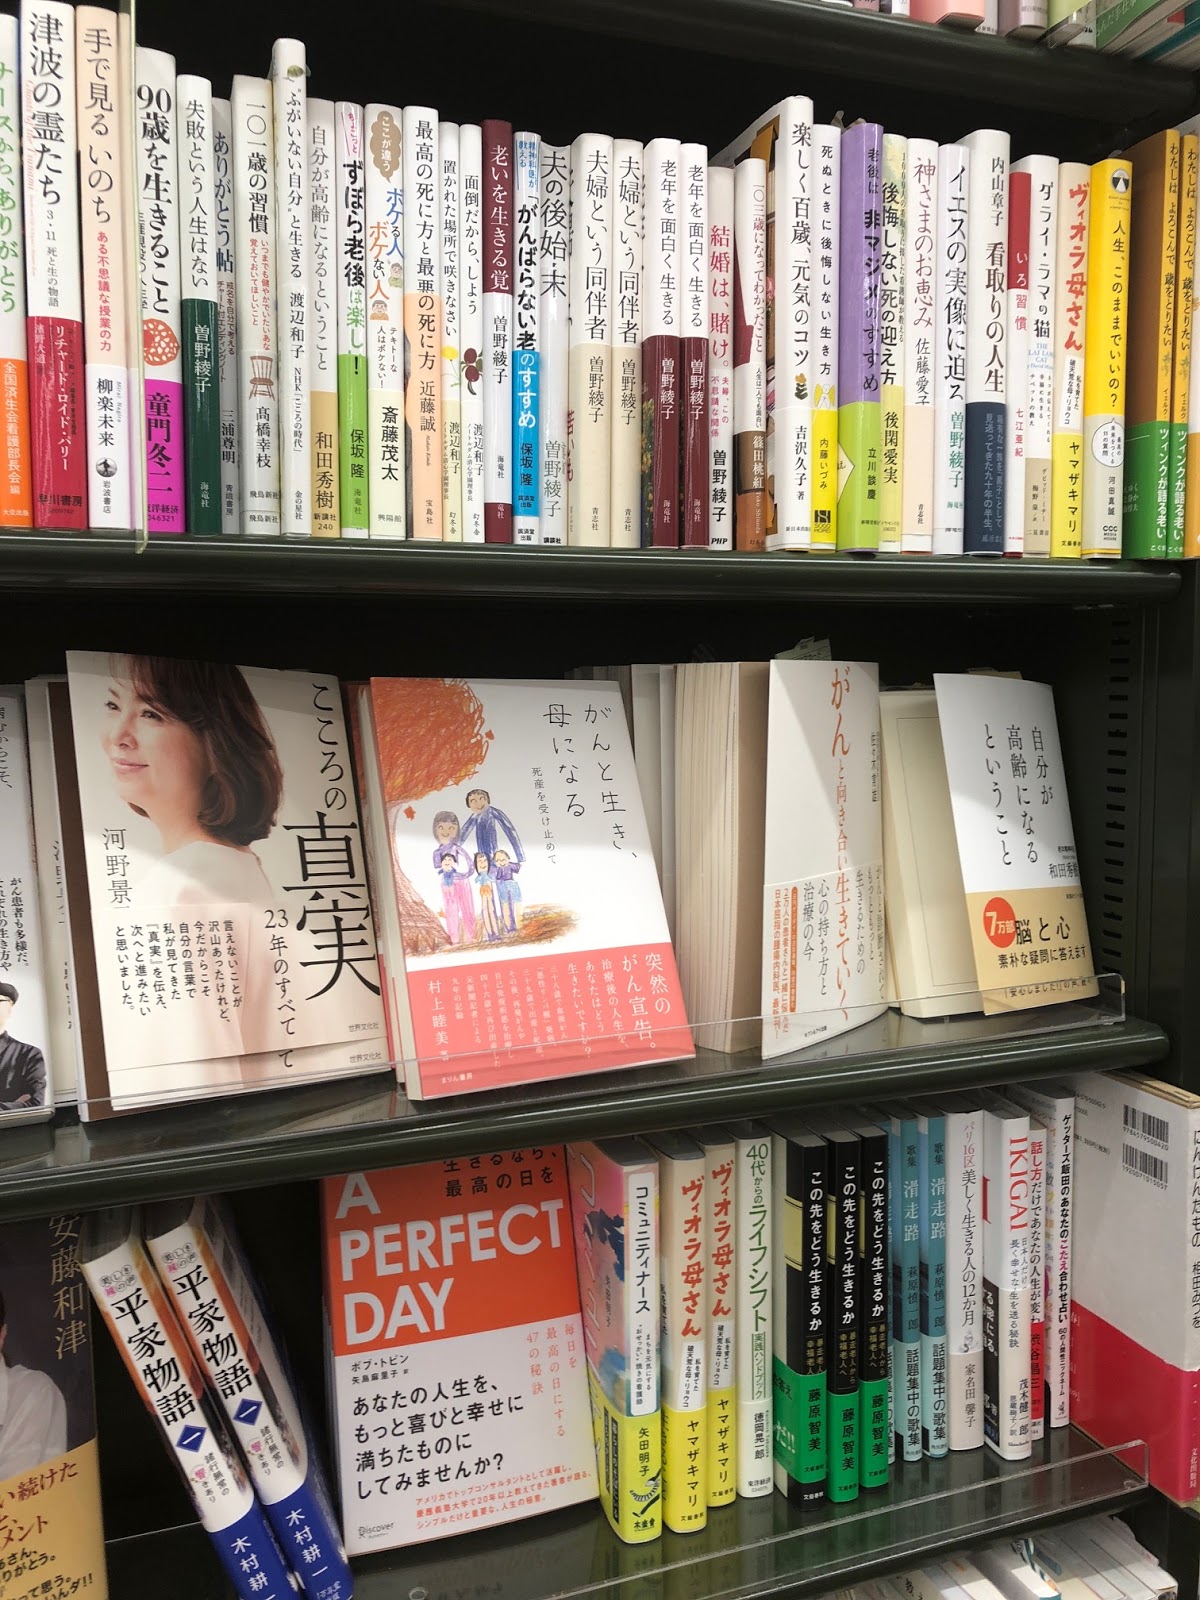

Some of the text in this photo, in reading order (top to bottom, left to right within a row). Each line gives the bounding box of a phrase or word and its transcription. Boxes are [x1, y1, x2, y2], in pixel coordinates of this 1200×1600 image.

[30, 12, 64, 205] 津波の霊たち
[381, 116, 391, 171] ここが違う
[136, 84, 173, 314] 90歳を生きること
[185, 100, 209, 288] 失敗という人生はない
[214, 131, 234, 274] ありがとう帖
[246, 103, 269, 235] 一〇一歳の習慣
[991, 156, 1004, 227] 内山章子
[311, 126, 330, 371] 自分が高齢になるということ
[415, 120, 436, 371] 最高の死に方と最悪の死に方
[442, 160, 458, 336] 置かれた場所で咲きなさい
[464, 174, 479, 315] 面倒だから、しよう
[490, 145, 510, 292] 老いを生きる覚
[540, 151, 567, 298] 夫の後始末
[585, 150, 609, 340] 夫婦という同伴者
[618, 156, 640, 344] 夫婦という同伴者
[660, 160, 676, 325] 老年を面白く生きる
[688, 165, 704, 327] 老年を面白く生きる
[791, 122, 811, 367] 楽しく百歳、元気のコツ
[820, 145, 833, 375] 死ぬときに後悔しない生き方
[913, 157, 936, 329] 神さまのお恵み
[1034, 181, 1053, 338] ダライ・ラマの猫
[46, 246, 60, 307] 死と生の物語
[97, 231, 111, 352] ある不思議な授業の力
[710, 226, 731, 367] 結婚は、賭け。
[752, 185, 765, 353] 一〇三歳になってわかったこと
[881, 182, 899, 385] 後悔しない死の迎え方
[1065, 181, 1090, 351] ヴィオラ母さん
[289, 293, 305, 358] 渡辺和子
[985, 241, 1006, 393] 看取りの人生
[1109, 220, 1128, 407] 人生、このままでいいの？
[56, 325, 72, 471] リチャード・ロイド・パリー
[97, 378, 115, 447] 柳楽未来
[419, 380, 436, 433] 近藤誠
[915, 338, 930, 405] 佐藤愛子
[147, 392, 173, 491] 童門冬二
[315, 432, 334, 509] 和田秀樹
[381, 406, 399, 481] 斎藤茂太
[795, 425, 807, 486] 吉沢久子
[820, 439, 829, 489] 内藤いづみ
[1067, 441, 1081, 533] ヤマザキマリ
[102, 480, 112, 514] 岩波書店
[542, 703, 585, 817] 母になる
[984, 724, 1012, 865] ということ
[1006, 724, 1038, 863] 高齢になる
[1032, 726, 1053, 805] 自分が
[116, 926, 135, 1010] と思いました。
[163, 922, 181, 1000] 私が見てきた
[179, 922, 198, 999] 自分の言葉で
[193, 921, 212, 997] 今だからこそ
[223, 920, 243, 1008] 言えないことが
[803, 883, 814, 960] 治療の今
[818, 879, 830, 995] 心の持ち方と
[985, 912, 1015, 937] 7万部
[998, 945, 1086, 969] 素朴な疑問に答えます
[1016, 916, 1070, 945] 脳と心
[130, 924, 152, 1016] 次へと進みたい
[208, 920, 231, 1022] 沢山あったけれど、
[264, 909, 296, 1035] 23年のすべて
[428, 980, 449, 1046] 村上睦美
[585, 960, 605, 1032] あなたはどう
[622, 953, 657, 1048] がん宣告。
[645, 952, 671, 1014] 突然の
[335, 1172, 381, 1219] A
[446, 1166, 554, 1198] 最高の日を
[904, 1180, 919, 1242] 滑走路
[931, 1177, 946, 1239] 滑走路
[1010, 1137, 1029, 1232] IKIGAI
[339, 1198, 564, 1281] PERFECT
[636, 1186, 650, 1314] コミュニティナース
[681, 1175, 704, 1337] ヴィオラ母さん
[712, 1160, 734, 1317] ヴィオラ母さん
[746, 1144, 769, 1331] 40代からのライフシフト
[809, 1171, 824, 1331] この先をどう生きるか
[842, 1166, 856, 1324] この先をどう生きるか
[871, 1161, 885, 1317] この先をどう生きるか
[111, 1287, 196, 1426] 平家物語
[172, 1264, 253, 1400] 平家物語
[344, 1278, 454, 1345] DAY
[565, 1324, 577, 1368] 毎日を
[351, 1355, 409, 1372] ボブ・トビン
[353, 1375, 498, 1416] あなたの人生を、
[546, 1327, 565, 1437] 最高の日にする
[754, 1334, 766, 1399] 実践ハンドブック
[906, 1348, 920, 1446] 話題集中の歌集
[932, 1342, 946, 1440] 話題集中の歌集
[1019, 1378, 1028, 1436] 茂木健一郎
[354, 1395, 524, 1443] もっと喜びと幸せに
[356, 1433, 472, 1472] 満ちたものに
[639, 1427, 650, 1477] 矢田明子
[687, 1420, 700, 1507] ヤマザキマリ
[718, 1399, 730, 1483] ヤマザキマリ
[808, 1388, 821, 1451] 藤原智美
[842, 1408, 855, 1470] 藤原智美
[872, 1394, 884, 1456] 藤原智美
[358, 1453, 504, 1500] してみませんか？
[286, 1508, 328, 1577] 木村耕一
